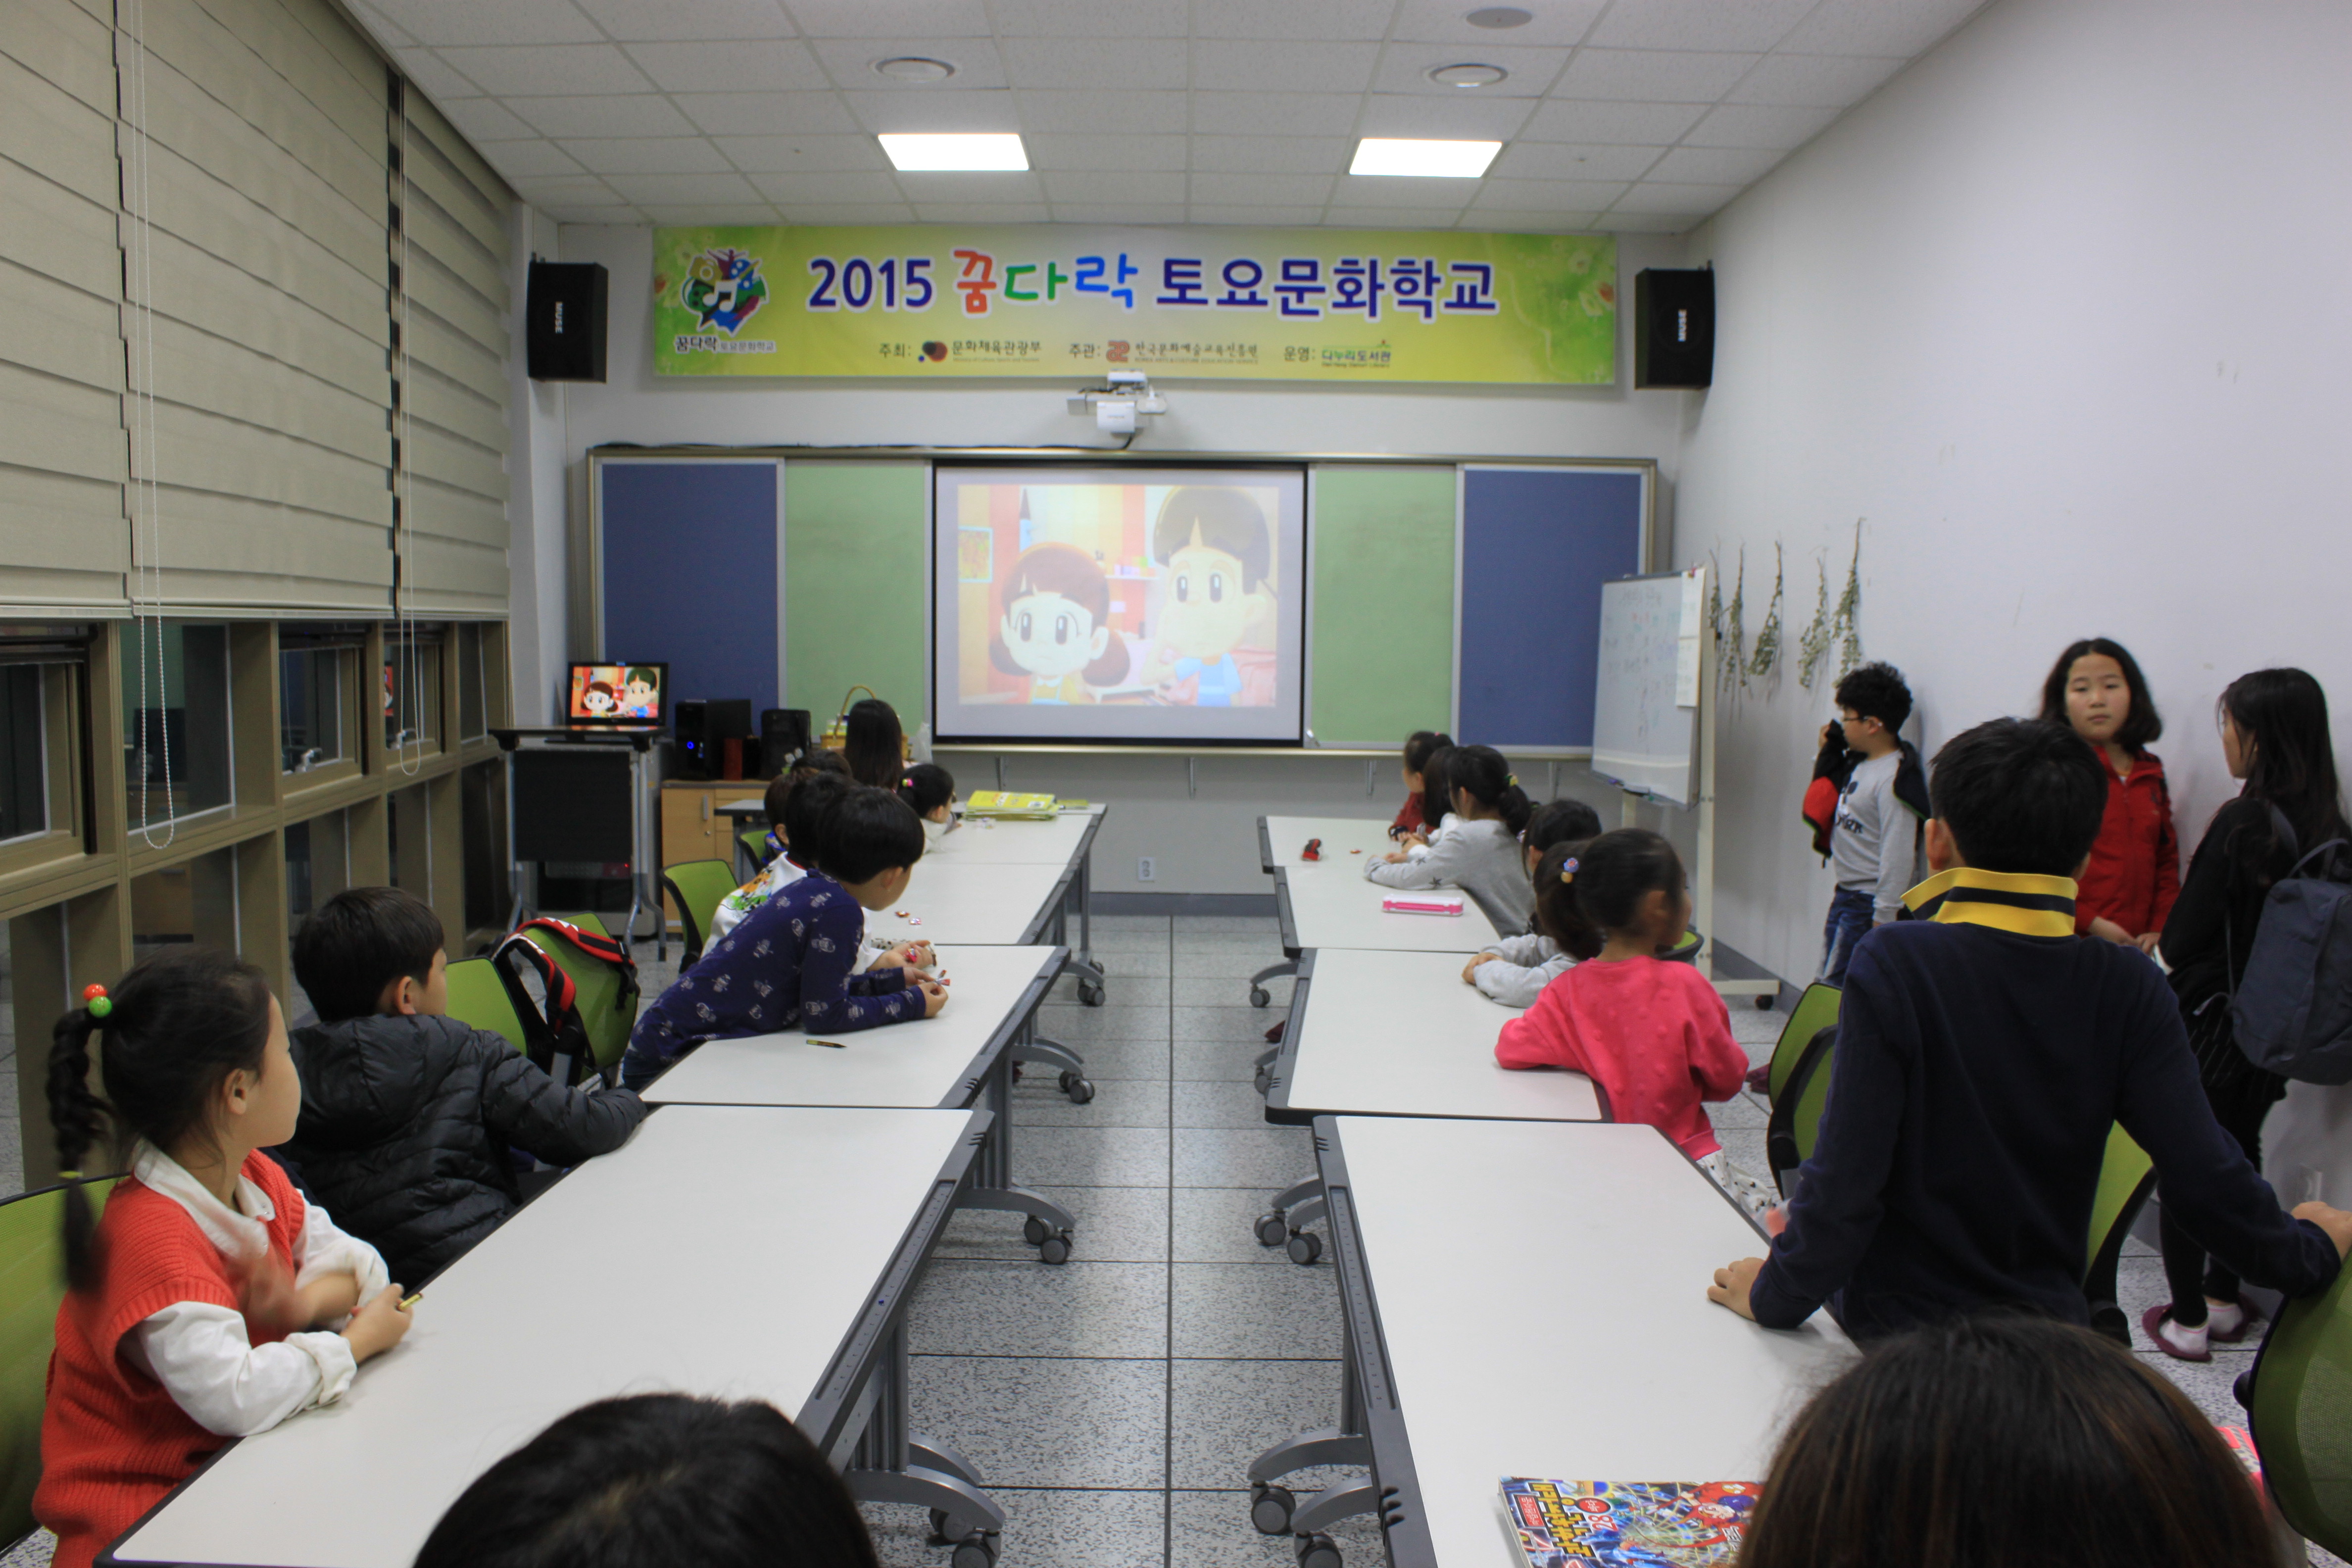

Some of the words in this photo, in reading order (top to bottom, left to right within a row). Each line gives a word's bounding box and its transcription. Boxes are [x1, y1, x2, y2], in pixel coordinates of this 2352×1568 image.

[809, 258, 933, 307] 2015
[953, 249, 1138, 314] 꿈다락
[1156, 257, 1496, 319] 토요문화학교
[676, 336, 717, 352] 꿈다락
[880, 343, 911, 358] 주최:
[952, 340, 1041, 355] 문화체육관광부
[1069, 343, 1100, 358] 주관:
[1284, 346, 1316, 362] 운영:
[1322, 349, 1391, 363] 다누리도서관
[1532, 1483, 1592, 1557] 과학원정대
[1588, 1515, 1618, 1532] 28
